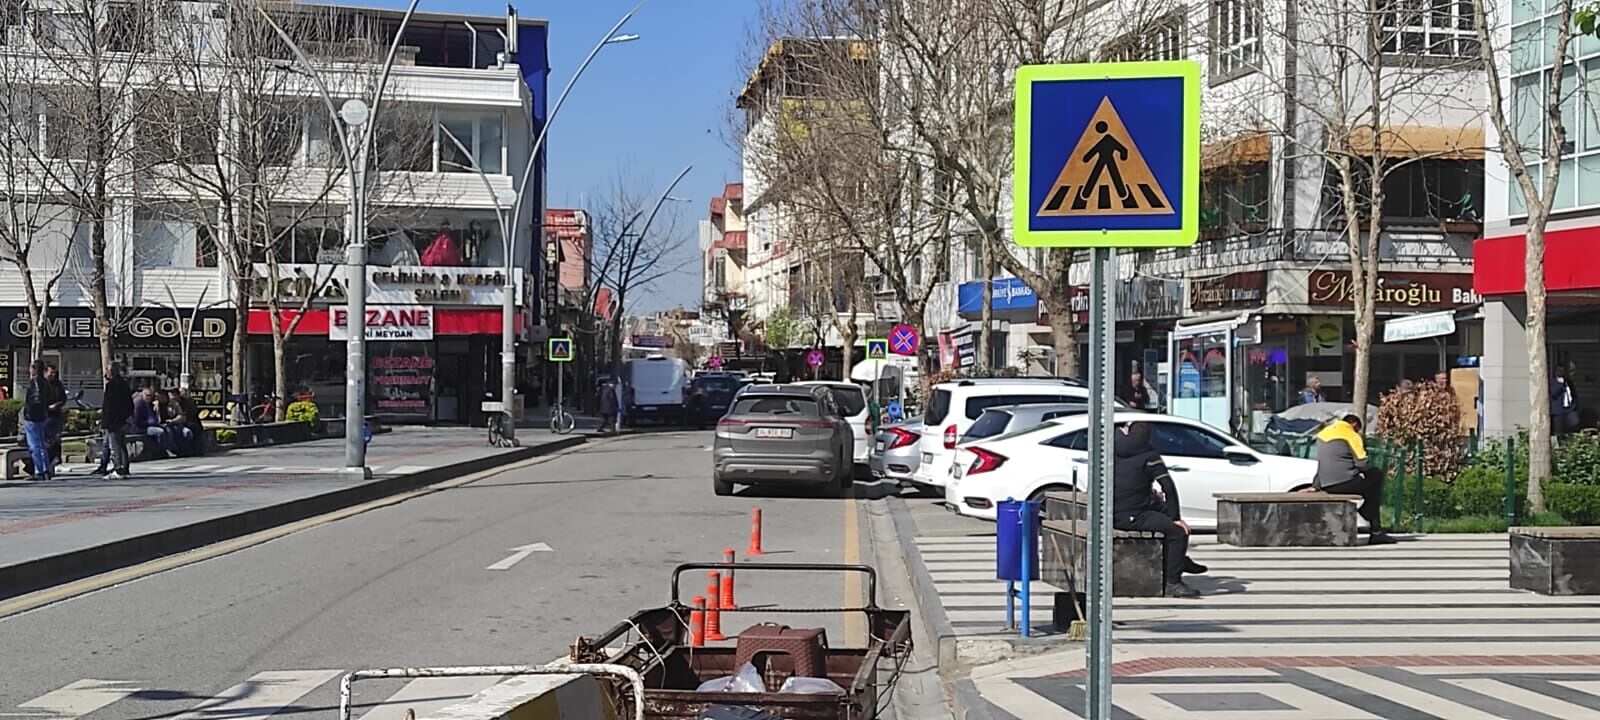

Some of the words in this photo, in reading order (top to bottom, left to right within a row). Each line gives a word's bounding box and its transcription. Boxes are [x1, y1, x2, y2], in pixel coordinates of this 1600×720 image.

[334, 309, 430, 327] EZANE
[128, 317, 227, 338] GOLD
[375, 330, 413, 338] MEYDAN
